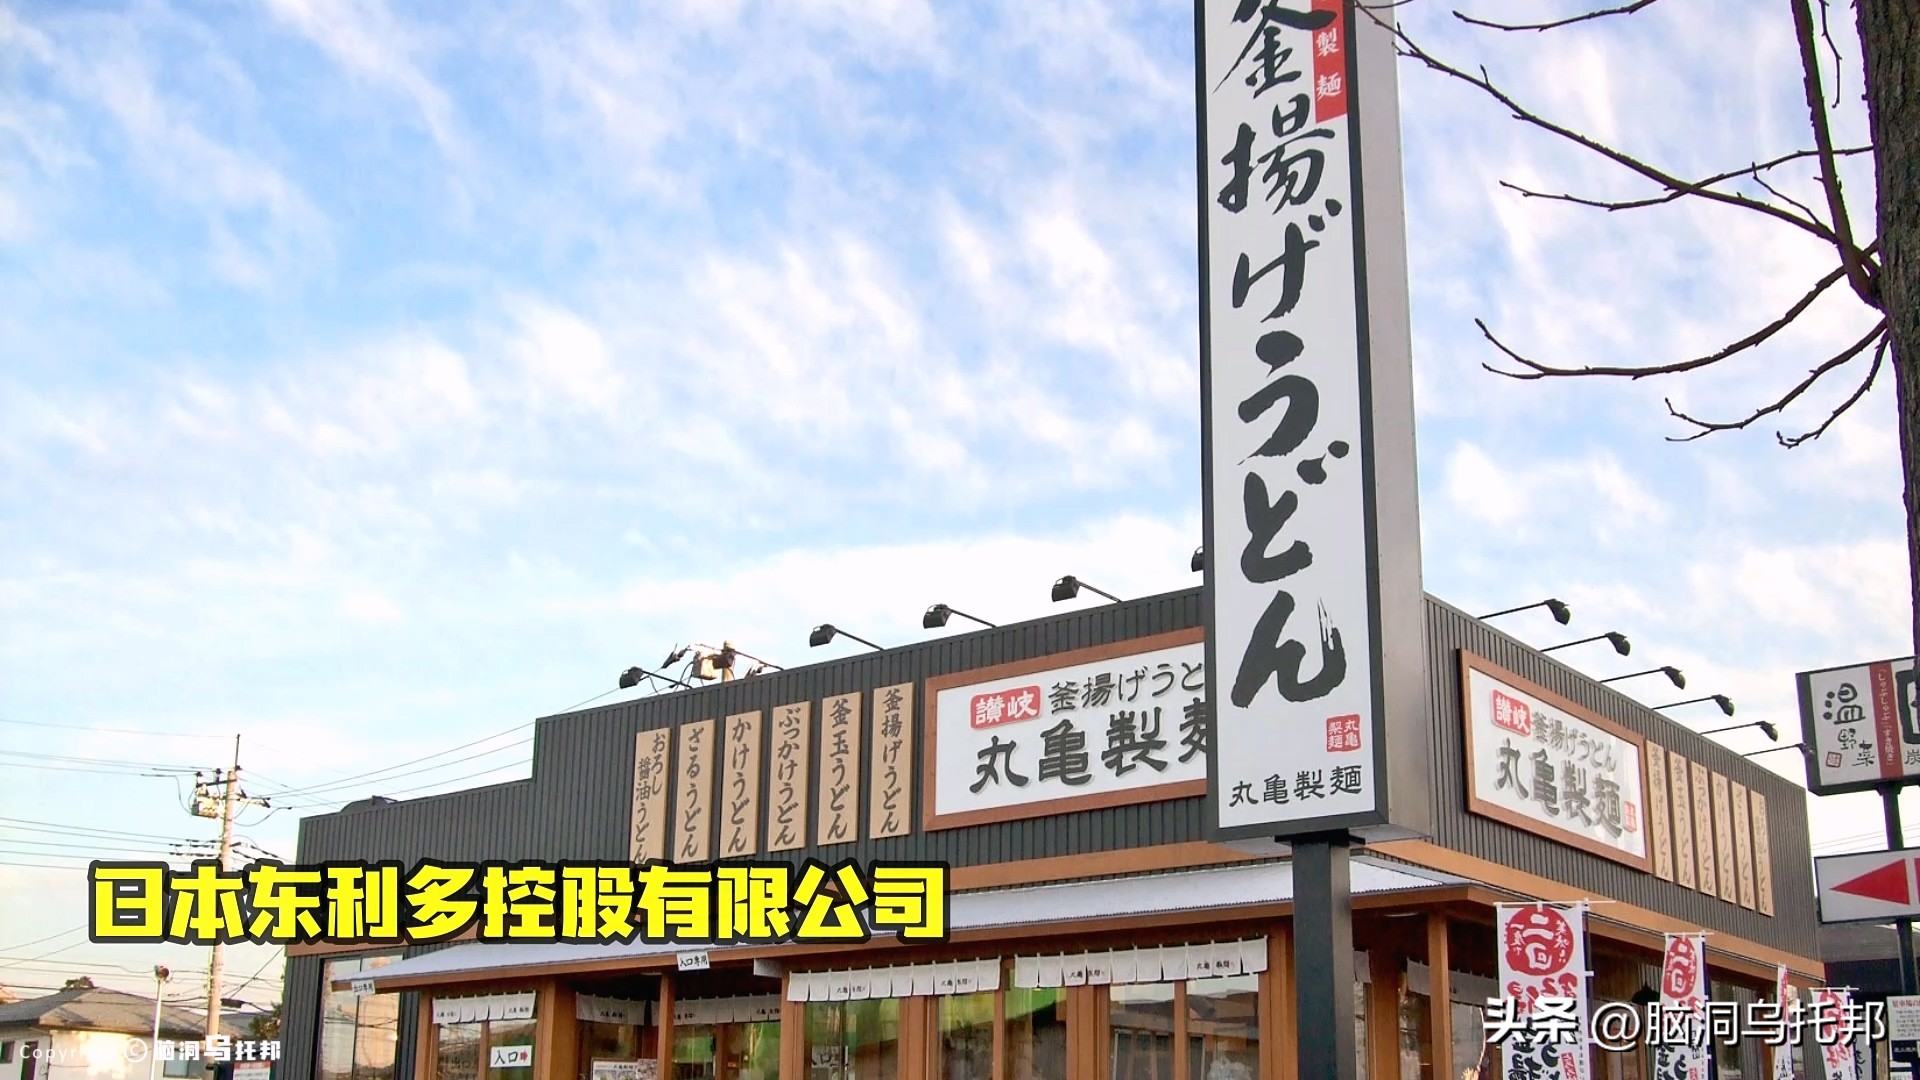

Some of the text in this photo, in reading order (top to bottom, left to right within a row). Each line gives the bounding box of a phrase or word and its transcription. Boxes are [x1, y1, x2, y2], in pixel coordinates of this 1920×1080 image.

[652, 733, 666, 795] おろし
[681, 727, 705, 858] ざるうどん
[727, 717, 752, 853] かけうどん
[774, 707, 802, 846] ぶっかけうどん
[827, 698, 853, 840] 釜玉うどん
[881, 688, 904, 834] 釜揚げうどん
[1229, 765, 1362, 807] 丸亀製麺
[1494, 737, 1623, 838] 丸亀製麺
[1532, 711, 1617, 772] 釜揚げうどん
[494, 1050, 518, 1065] 入口
